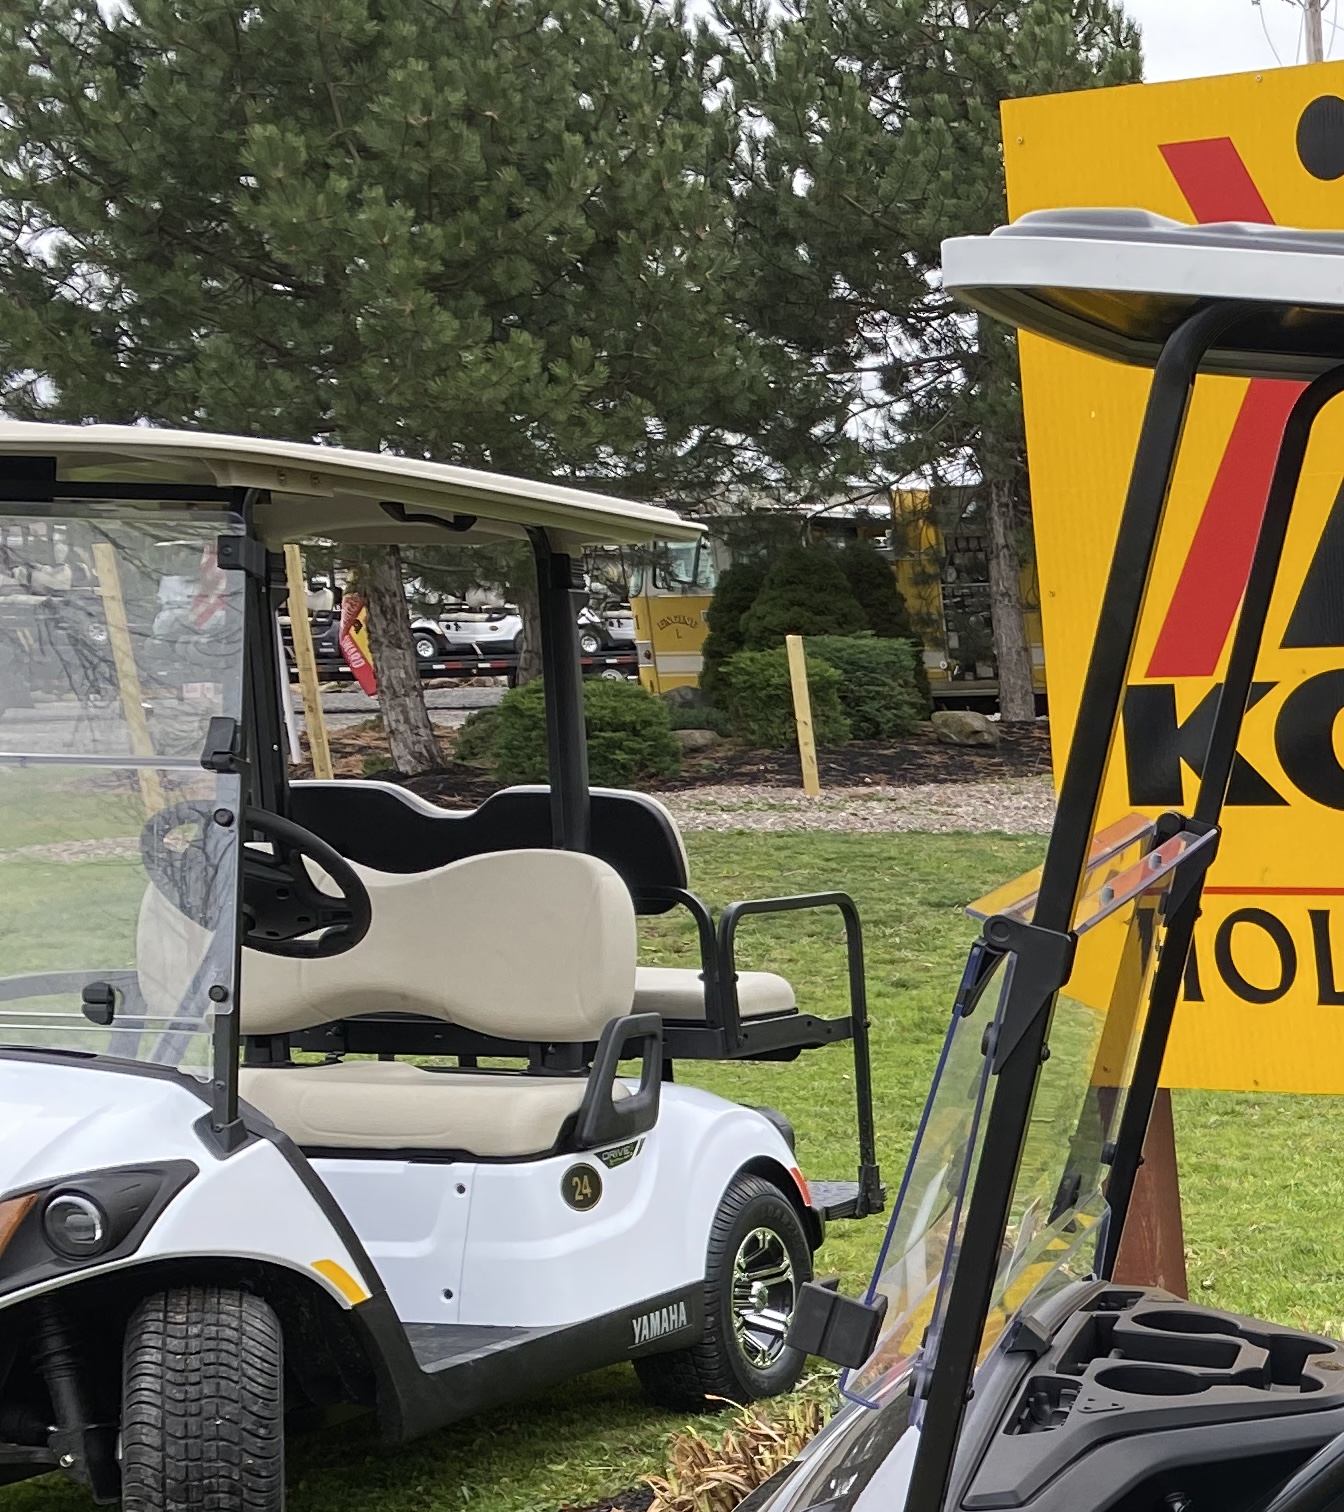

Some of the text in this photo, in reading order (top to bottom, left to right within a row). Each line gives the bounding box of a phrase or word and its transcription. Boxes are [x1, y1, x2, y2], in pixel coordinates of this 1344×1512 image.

[656, 614, 699, 631] ENGINE
[572, 1175, 592, 1201] 24
[632, 1301, 688, 1344] YAMAHA
